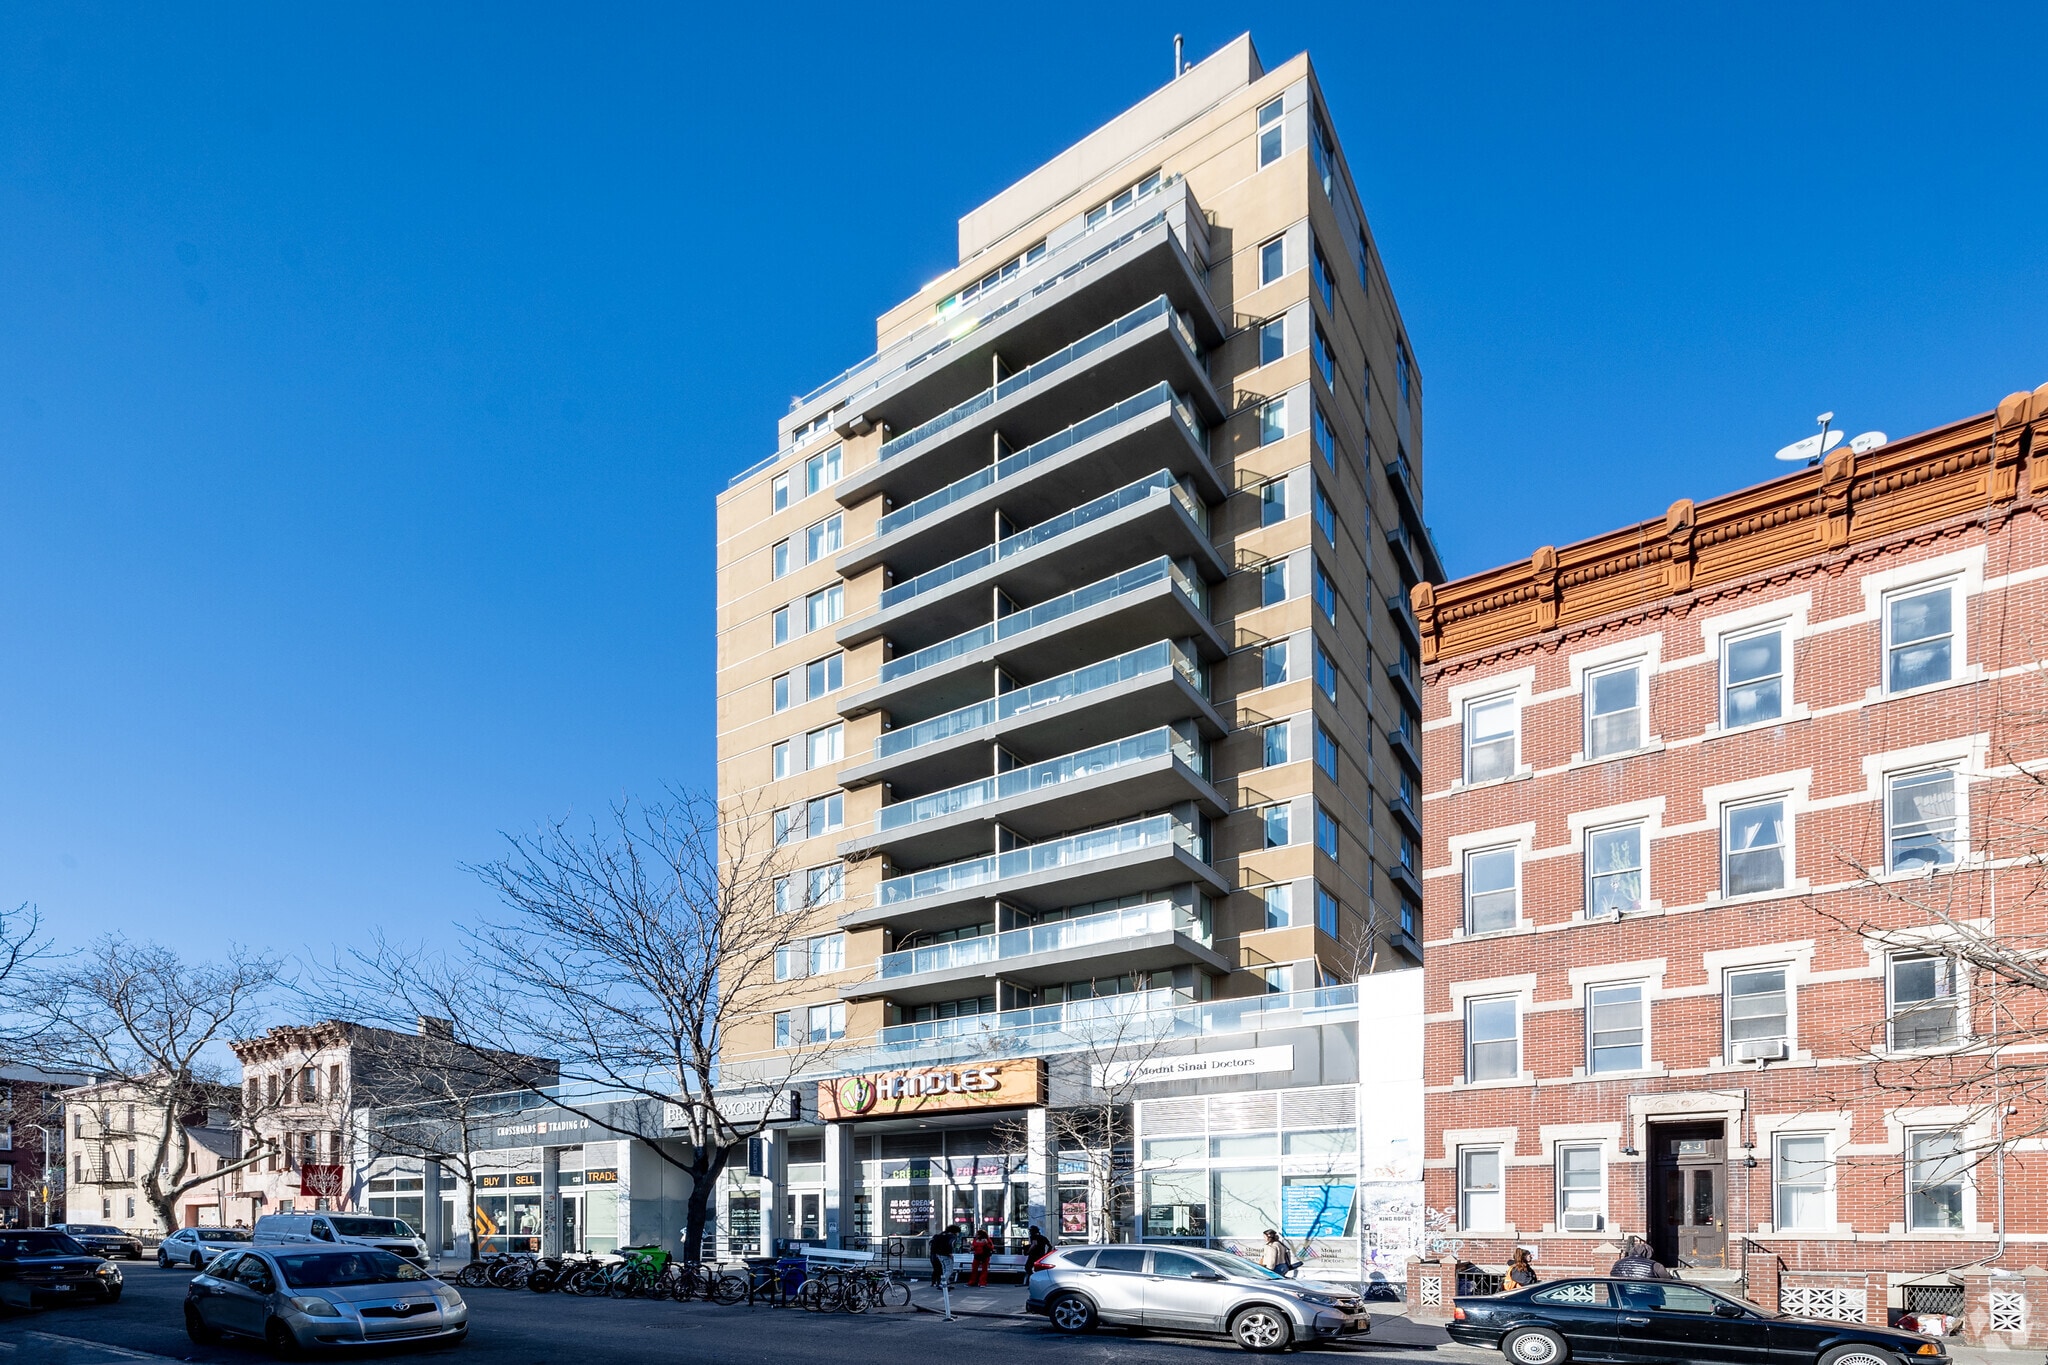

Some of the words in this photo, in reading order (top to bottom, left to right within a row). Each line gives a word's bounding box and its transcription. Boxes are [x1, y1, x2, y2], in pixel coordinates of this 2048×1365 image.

[1138, 1064, 1174, 1076] Mount
[1177, 1061, 1207, 1073] Sinai
[1211, 1057, 1255, 1070] Doctors
[876, 1067, 1000, 1100] HANDLES
[496, 1124, 537, 1137] CROSSROADS
[548, 1120, 578, 1132] TRADING
[580, 1119, 592, 1129] CO.
[483, 1177, 500, 1187] BUY
[515, 1175, 535, 1185] SELL
[587, 1171, 618, 1182] TRADE
